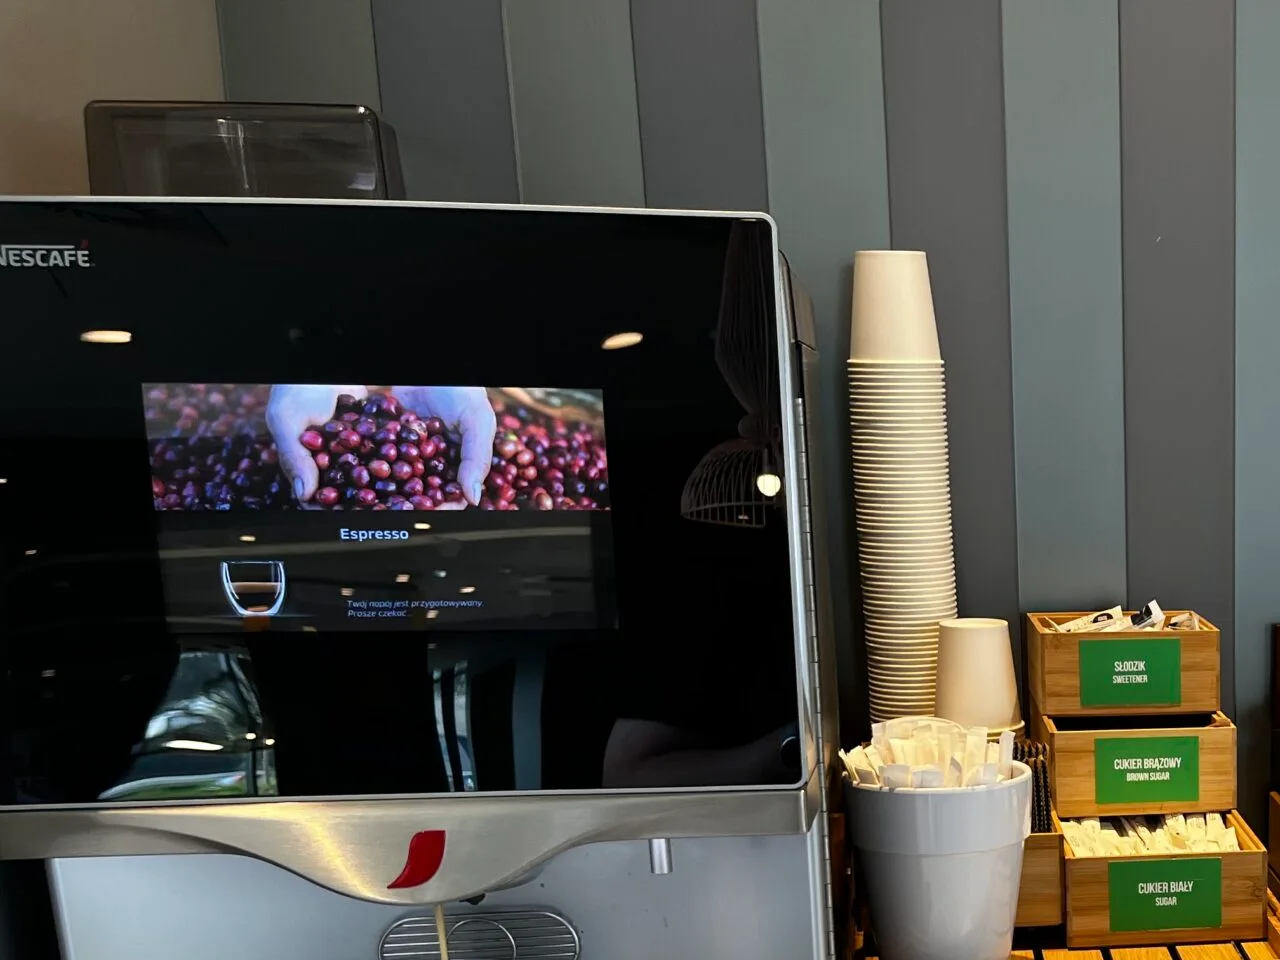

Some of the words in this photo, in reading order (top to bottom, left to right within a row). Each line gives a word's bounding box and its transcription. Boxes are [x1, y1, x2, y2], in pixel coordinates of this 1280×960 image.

[340, 528, 409, 541] Espresso
[1114, 660, 1146, 672] SŁODZIK
[1112, 674, 1148, 684] SWEETENER
[1114, 758, 1142, 770] CUKIER
[1143, 757, 1181, 770] BRĄZOWY
[1126, 772, 1149, 782] BROWN
[1149, 771, 1170, 781] SUGAR
[1138, 882, 1169, 894] CUKIER
[1170, 880, 1194, 893] BIAŁY
[1155, 896, 1177, 906] SUGAR
